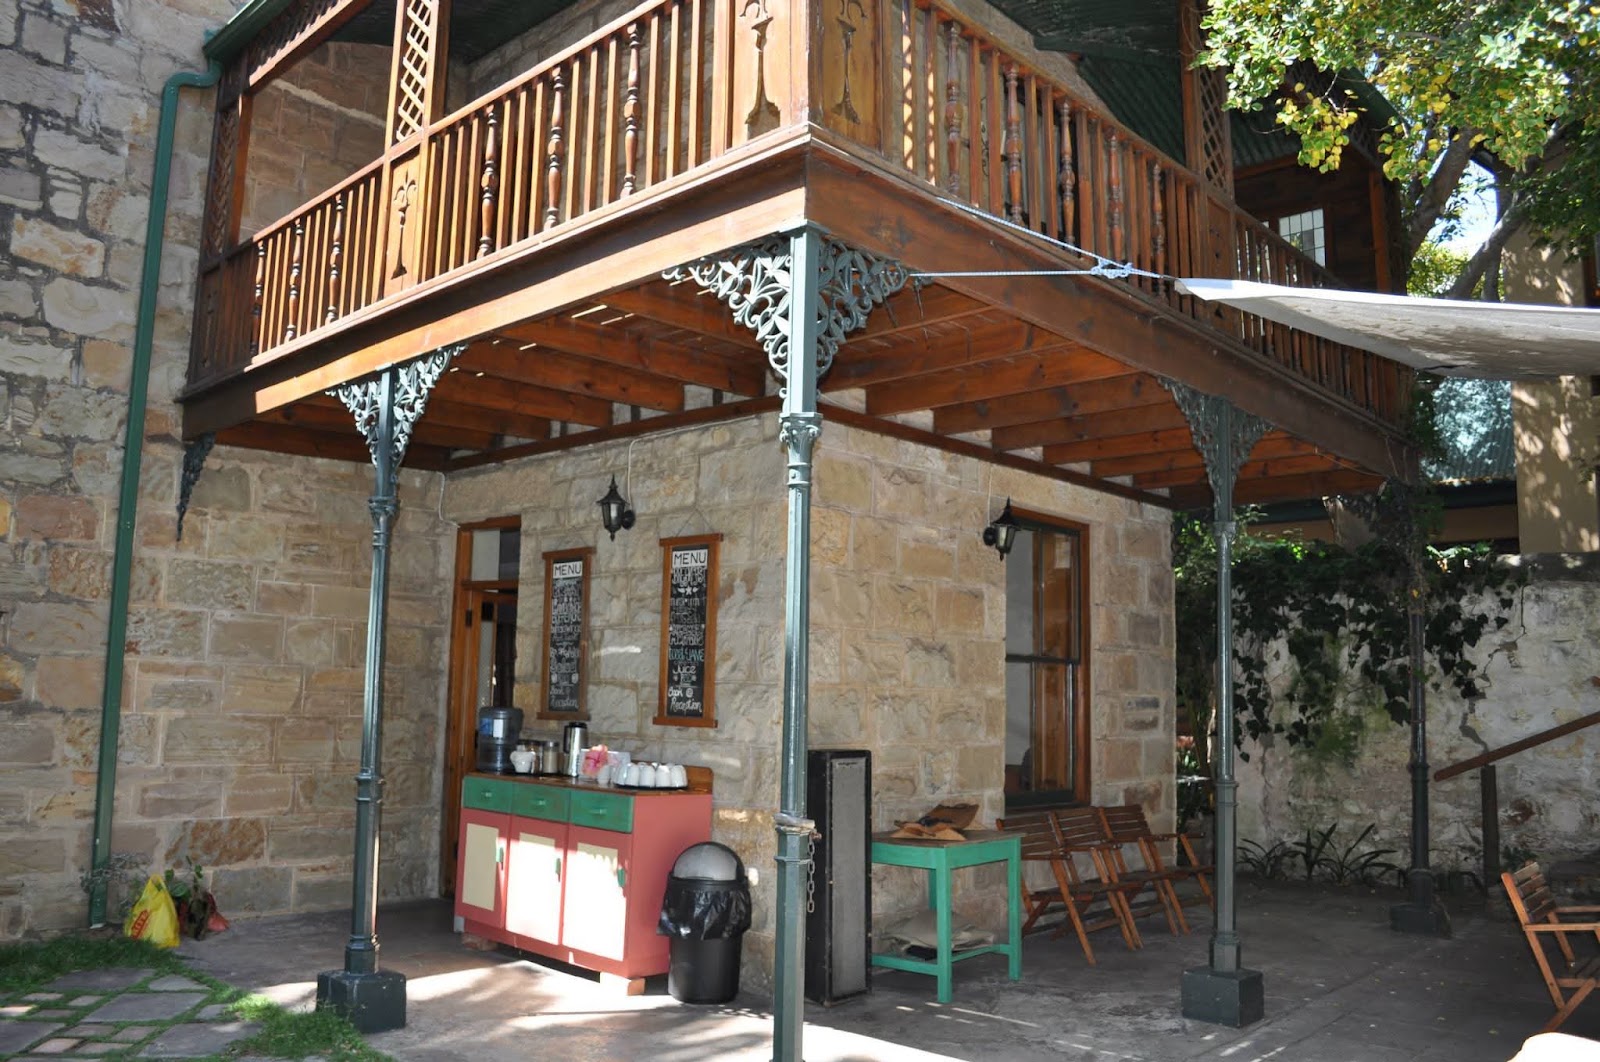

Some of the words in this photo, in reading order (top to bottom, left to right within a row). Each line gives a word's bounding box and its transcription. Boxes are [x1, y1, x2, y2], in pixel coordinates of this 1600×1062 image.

[673, 551, 707, 566] MENU
[554, 564, 582, 577] MENU
[672, 665, 696, 674] Juice
[668, 686, 684, 697] Book
